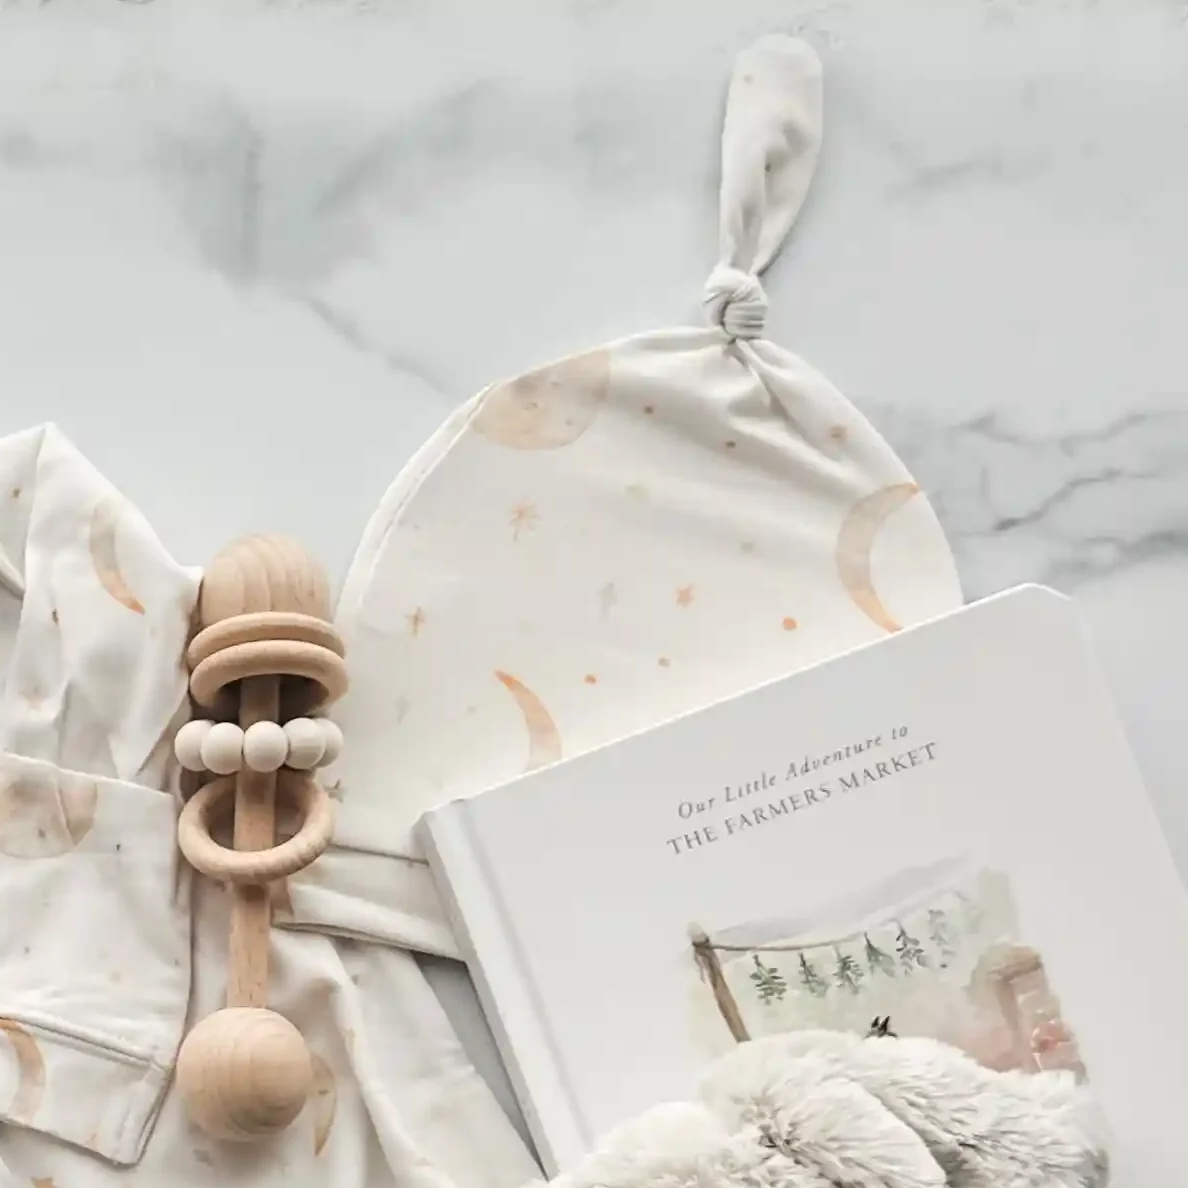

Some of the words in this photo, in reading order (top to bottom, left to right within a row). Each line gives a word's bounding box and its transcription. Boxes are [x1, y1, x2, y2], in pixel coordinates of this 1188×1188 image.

[666, 826, 718, 855] THE
[724, 782, 831, 835] FARMERS
[838, 741, 936, 793] MARKET
[678, 798, 715, 819] Our
[724, 771, 776, 803] Little
[785, 736, 881, 781] Adventure
[892, 726, 908, 740] to
